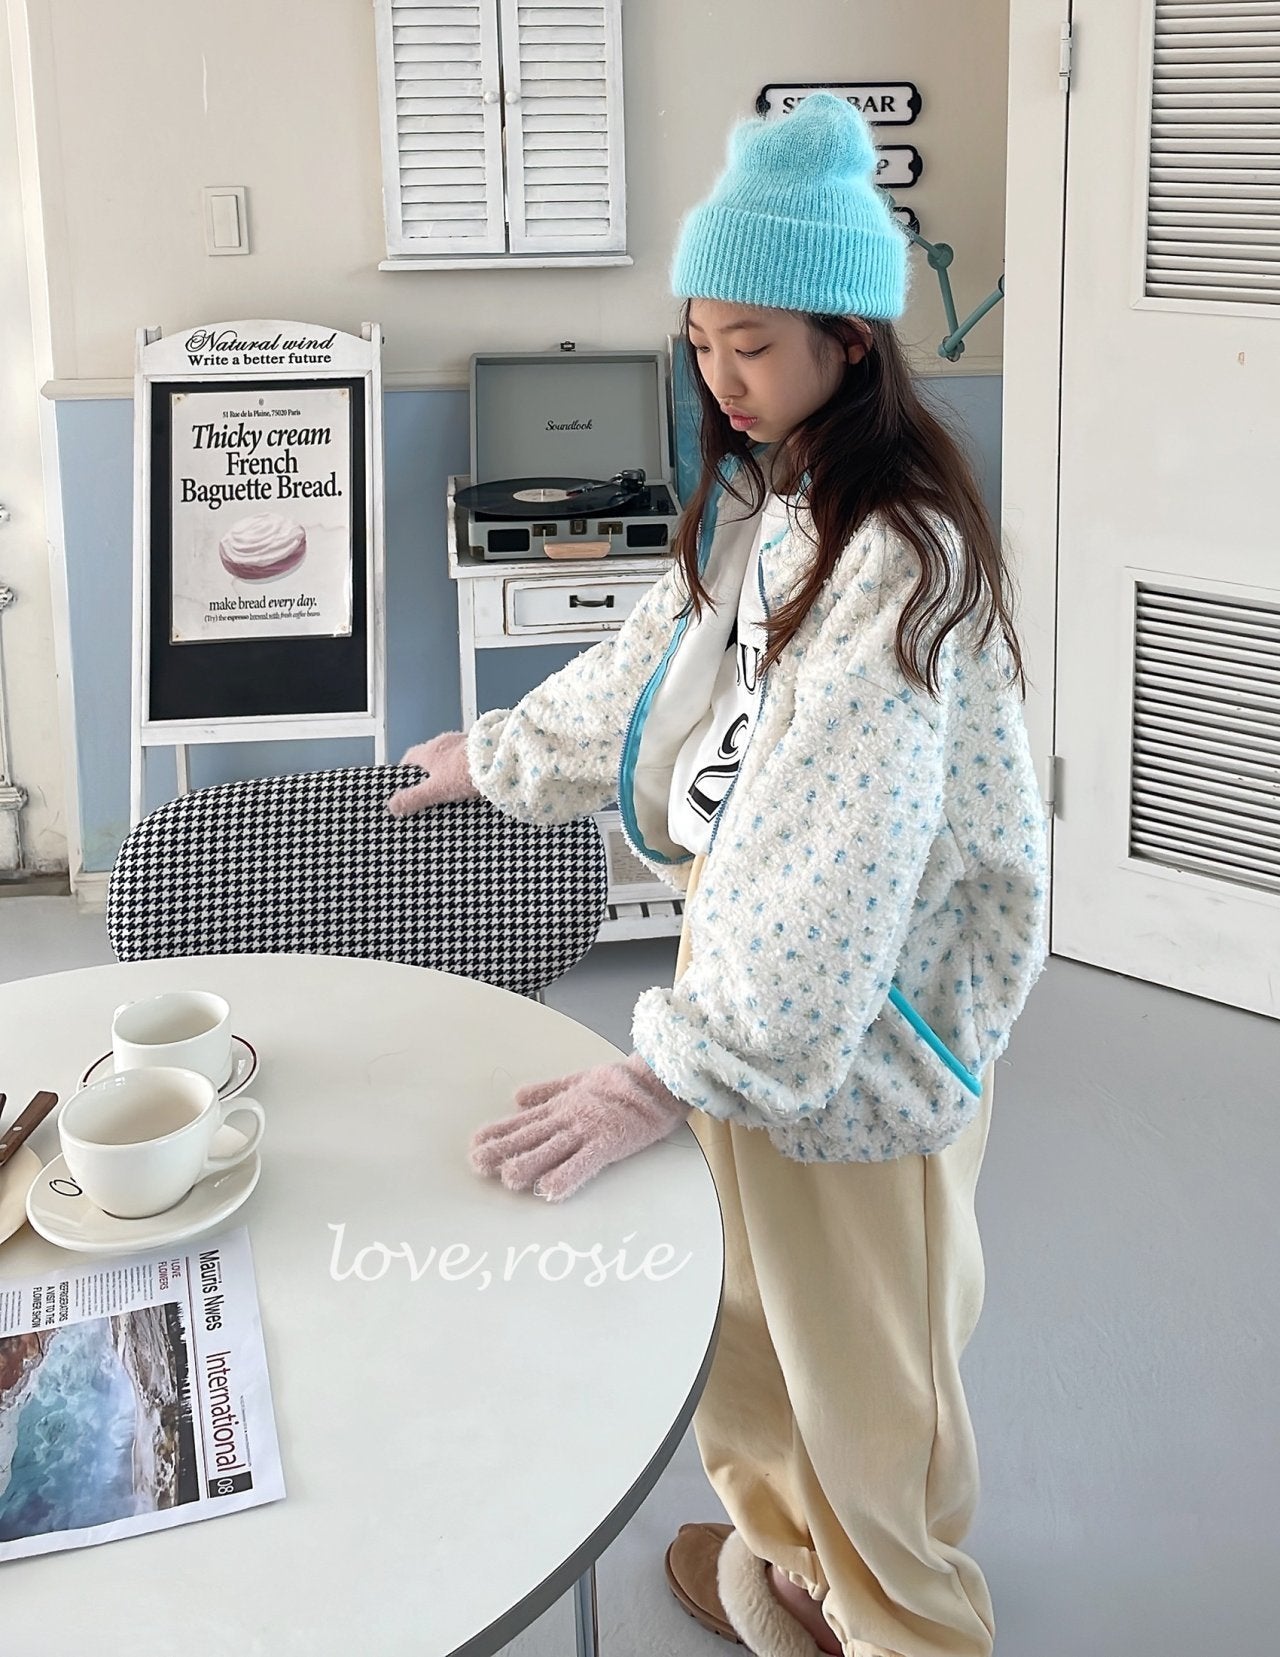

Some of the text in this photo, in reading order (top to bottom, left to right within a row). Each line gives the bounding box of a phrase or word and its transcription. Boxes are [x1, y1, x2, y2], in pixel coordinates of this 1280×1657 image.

[185, 329, 338, 353] Natural wind
[187, 352, 331, 366] Write a better future
[545, 418, 593, 431] Soundlook
[191, 422, 332, 455] Thicky cream
[225, 449, 299, 476] French
[180, 472, 343, 510] Baguette Bread.
[209, 594, 317, 612] make bread every day.
[158, 1261, 169, 1291] FLOWERS
[171, 1262, 182, 1279] LOVE
[199, 1249, 225, 1331] Mauris Nwes
[31, 1287, 42, 1329] FLOWER SHOW
[45, 1304, 54, 1313] TO
[45, 1313, 54, 1326] THE
[206, 1350, 246, 1472] International
[217, 1478, 234, 1494] 08
